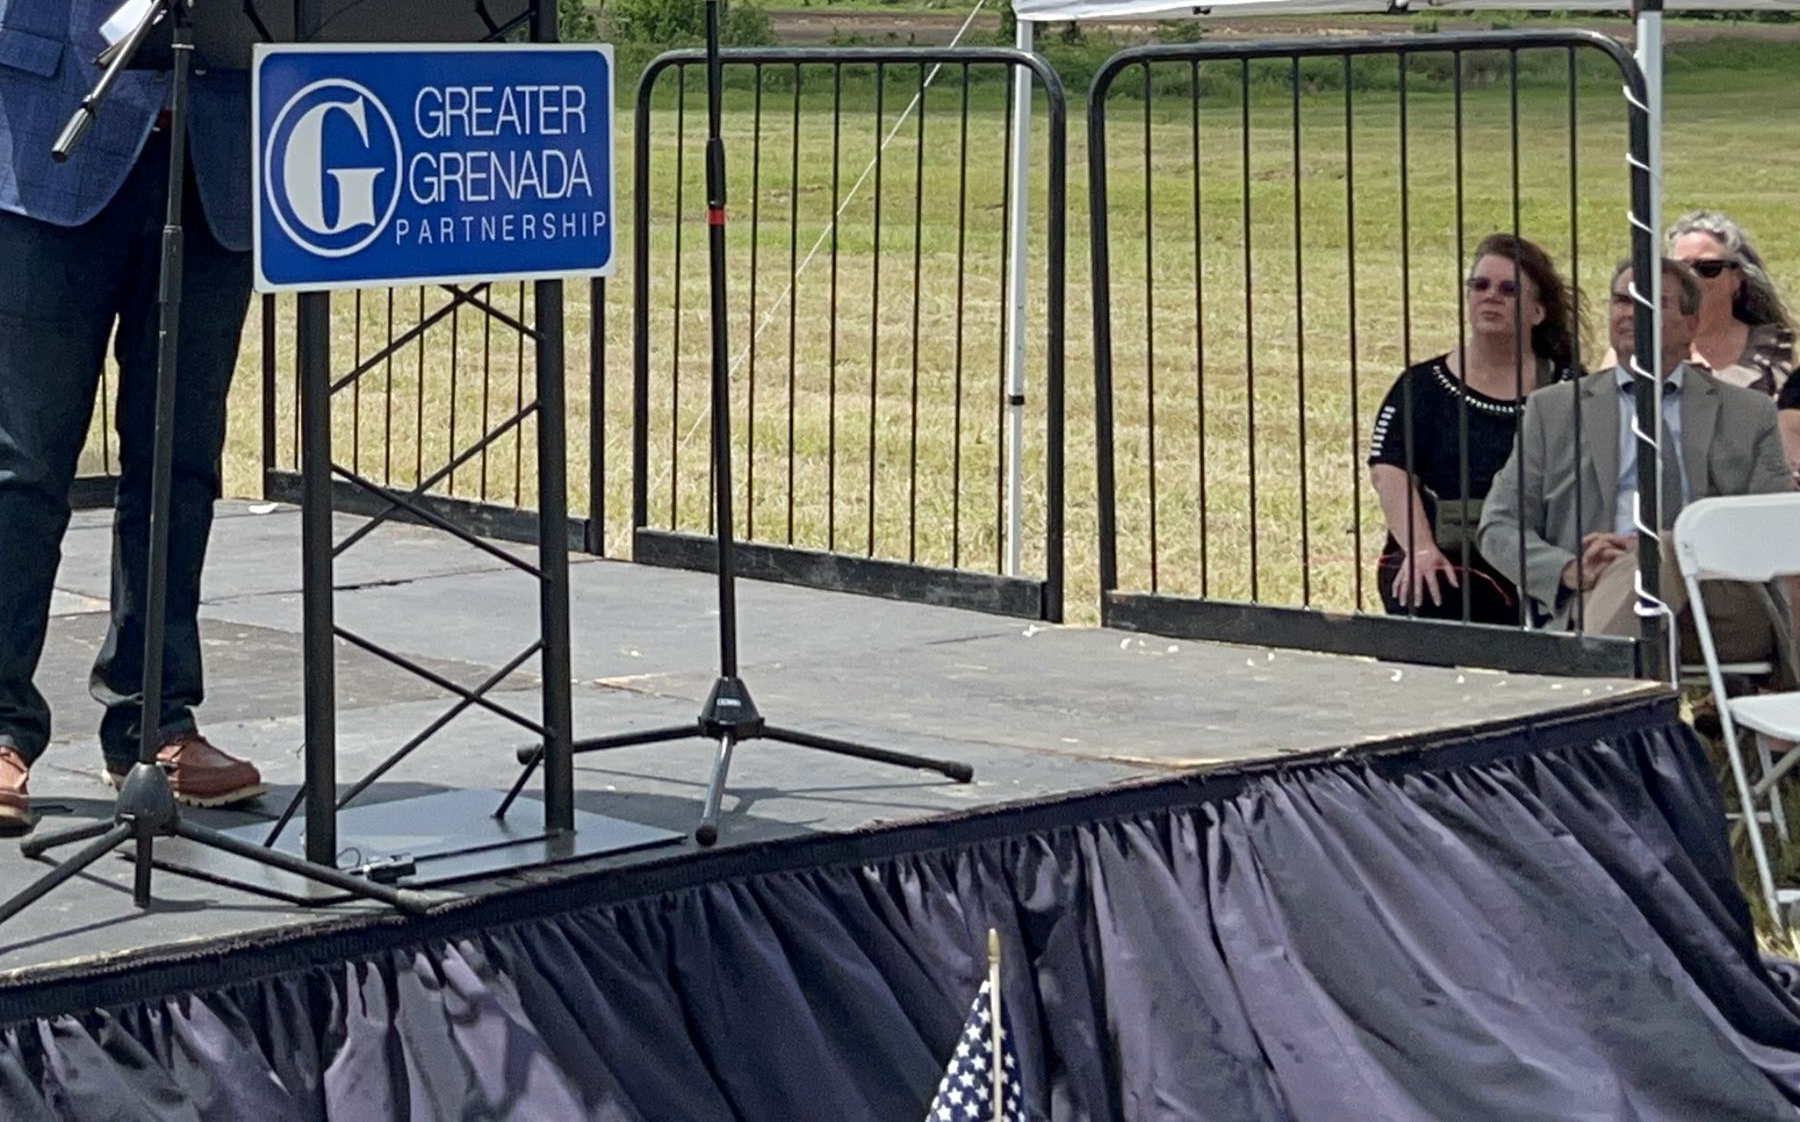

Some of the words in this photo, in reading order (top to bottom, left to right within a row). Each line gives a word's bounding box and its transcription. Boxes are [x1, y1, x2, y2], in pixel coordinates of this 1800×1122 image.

[414, 85, 587, 139] GREATER
[284, 95, 385, 234] G
[409, 149, 593, 204] GRENADA
[396, 211, 606, 245] PARTNERSHIP
